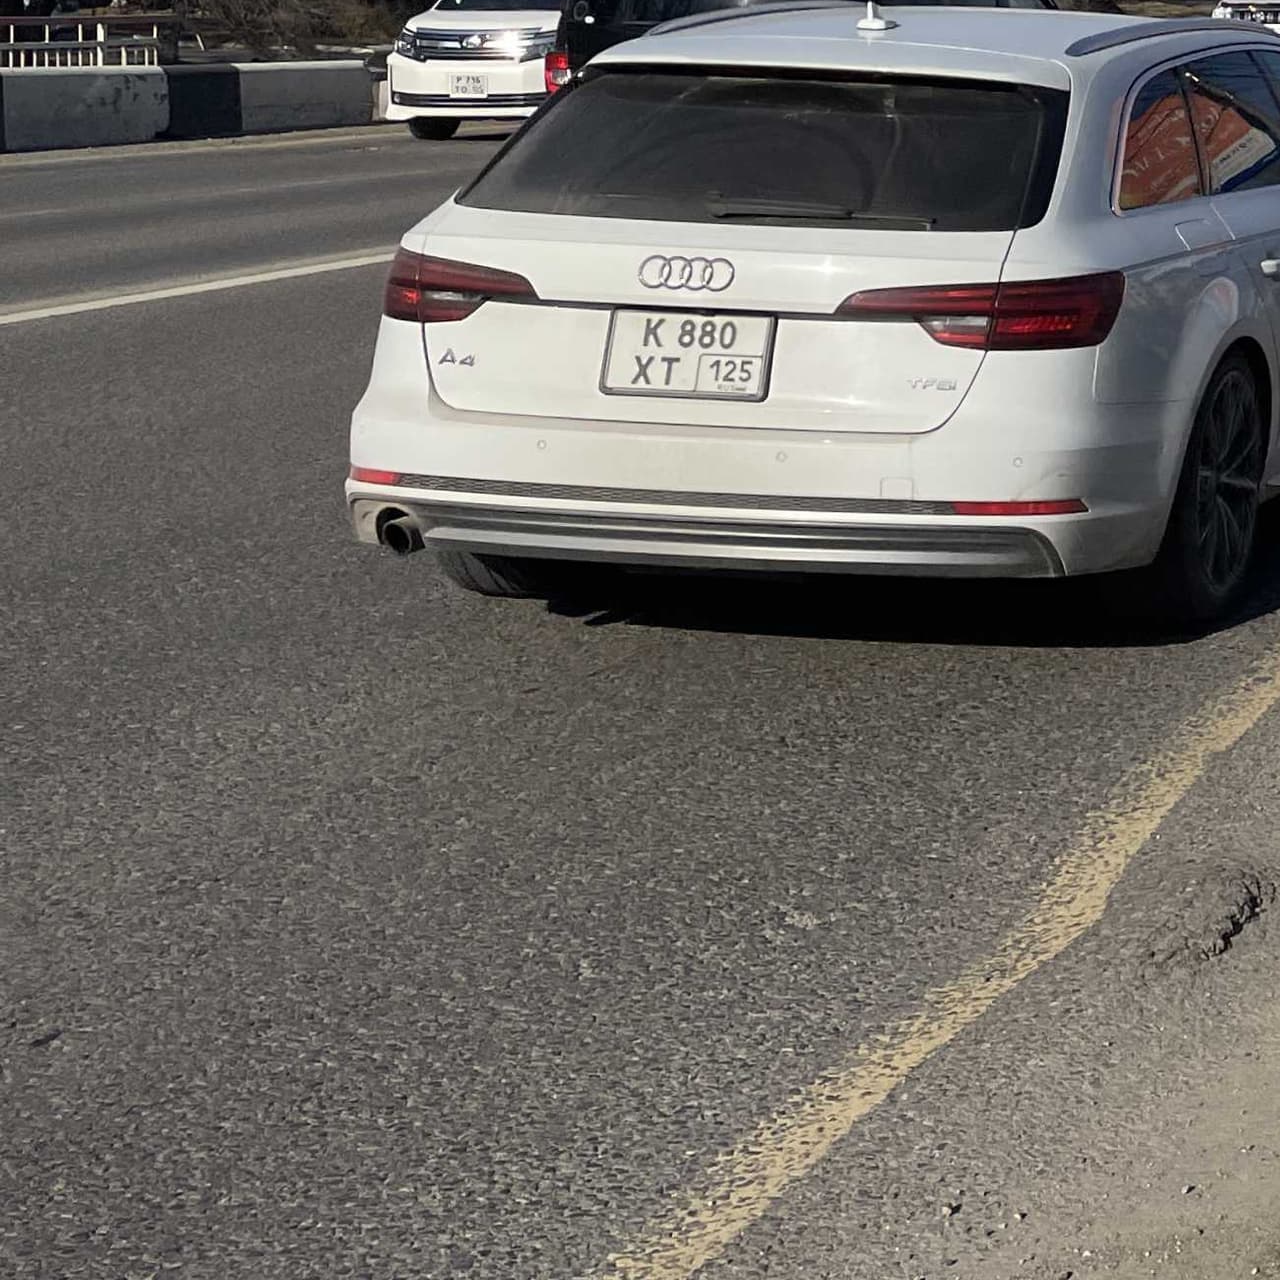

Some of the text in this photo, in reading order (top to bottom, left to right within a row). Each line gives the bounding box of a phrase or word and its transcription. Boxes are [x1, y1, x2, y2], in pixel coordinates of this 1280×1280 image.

[678, 320, 737, 349] 880
[438, 348, 476, 367] A4
[709, 360, 753, 382] 125
